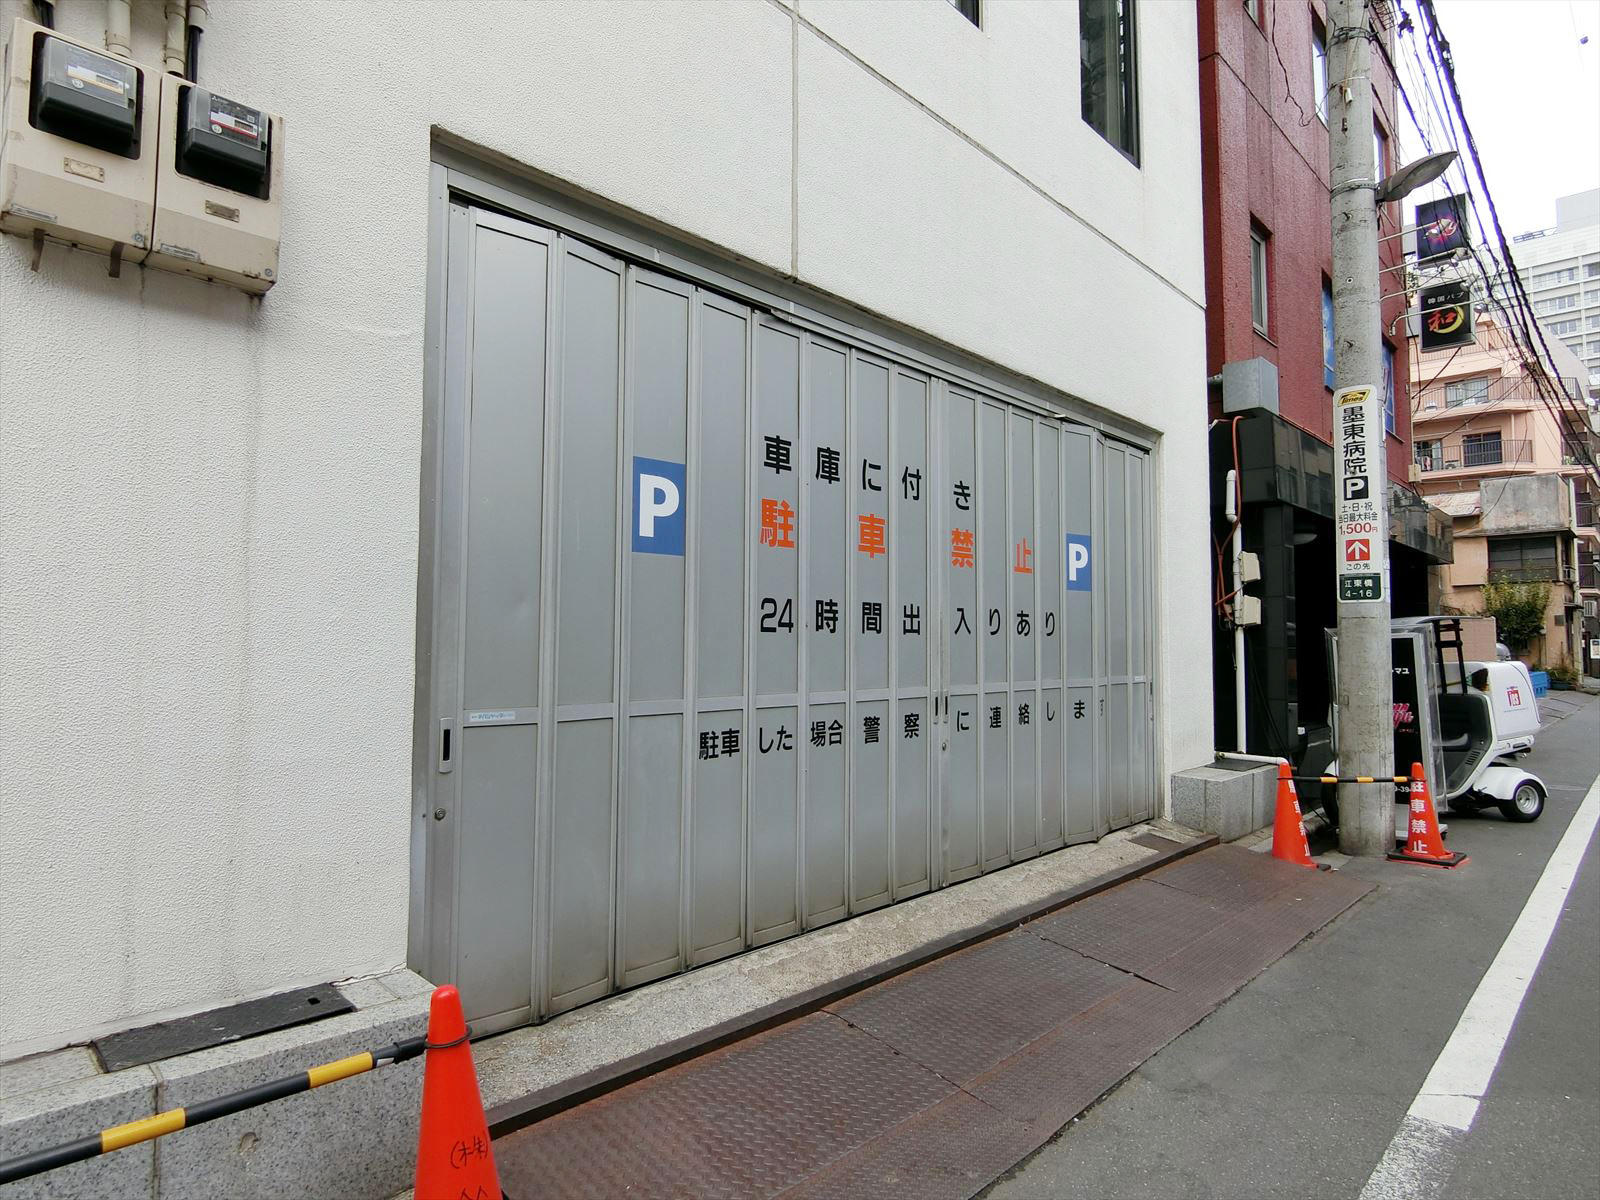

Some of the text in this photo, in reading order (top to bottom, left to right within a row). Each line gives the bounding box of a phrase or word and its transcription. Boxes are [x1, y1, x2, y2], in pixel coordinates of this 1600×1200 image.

[1342, 405, 1367, 476] 墨東病院
[763, 435, 972, 511] 車庫に付き
[1346, 478, 1366, 499] P
[638, 474, 680, 538] P
[760, 499, 1034, 575] 駐車禁止
[1068, 543, 1089, 582] P
[1346, 563, 1371, 571] この先
[760, 597, 1056, 637] 24時間出入りあり
[1410, 781, 1429, 854] 駐車禁止
